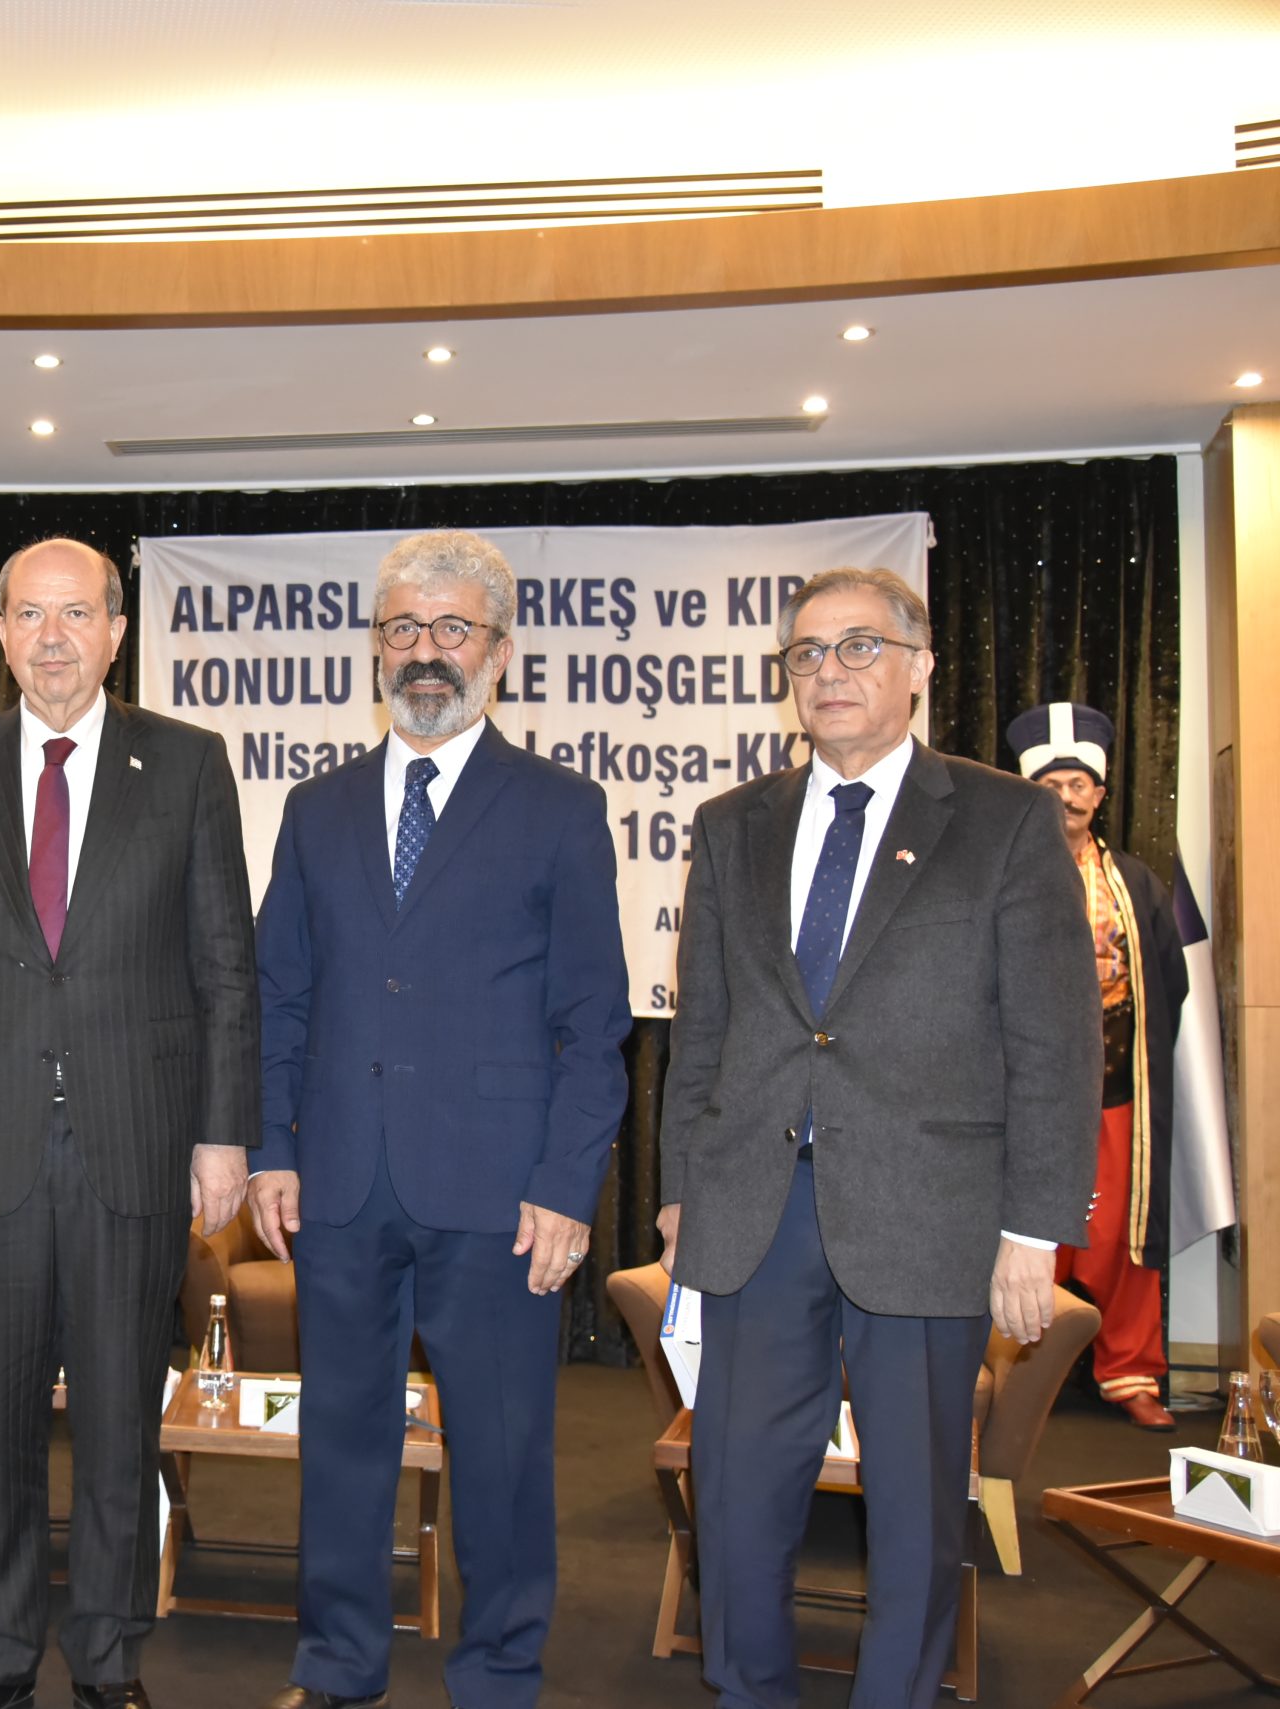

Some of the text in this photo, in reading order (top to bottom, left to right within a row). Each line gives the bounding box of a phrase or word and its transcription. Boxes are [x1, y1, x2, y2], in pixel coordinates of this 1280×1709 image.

[170, 582, 377, 633] ALPARSL
[516, 577, 637, 641] RKEŞ
[654, 589, 707, 628] ve
[172, 656, 352, 707] KONULU
[567, 653, 790, 719] HOŞGELD
[620, 810, 693, 861] 16:
